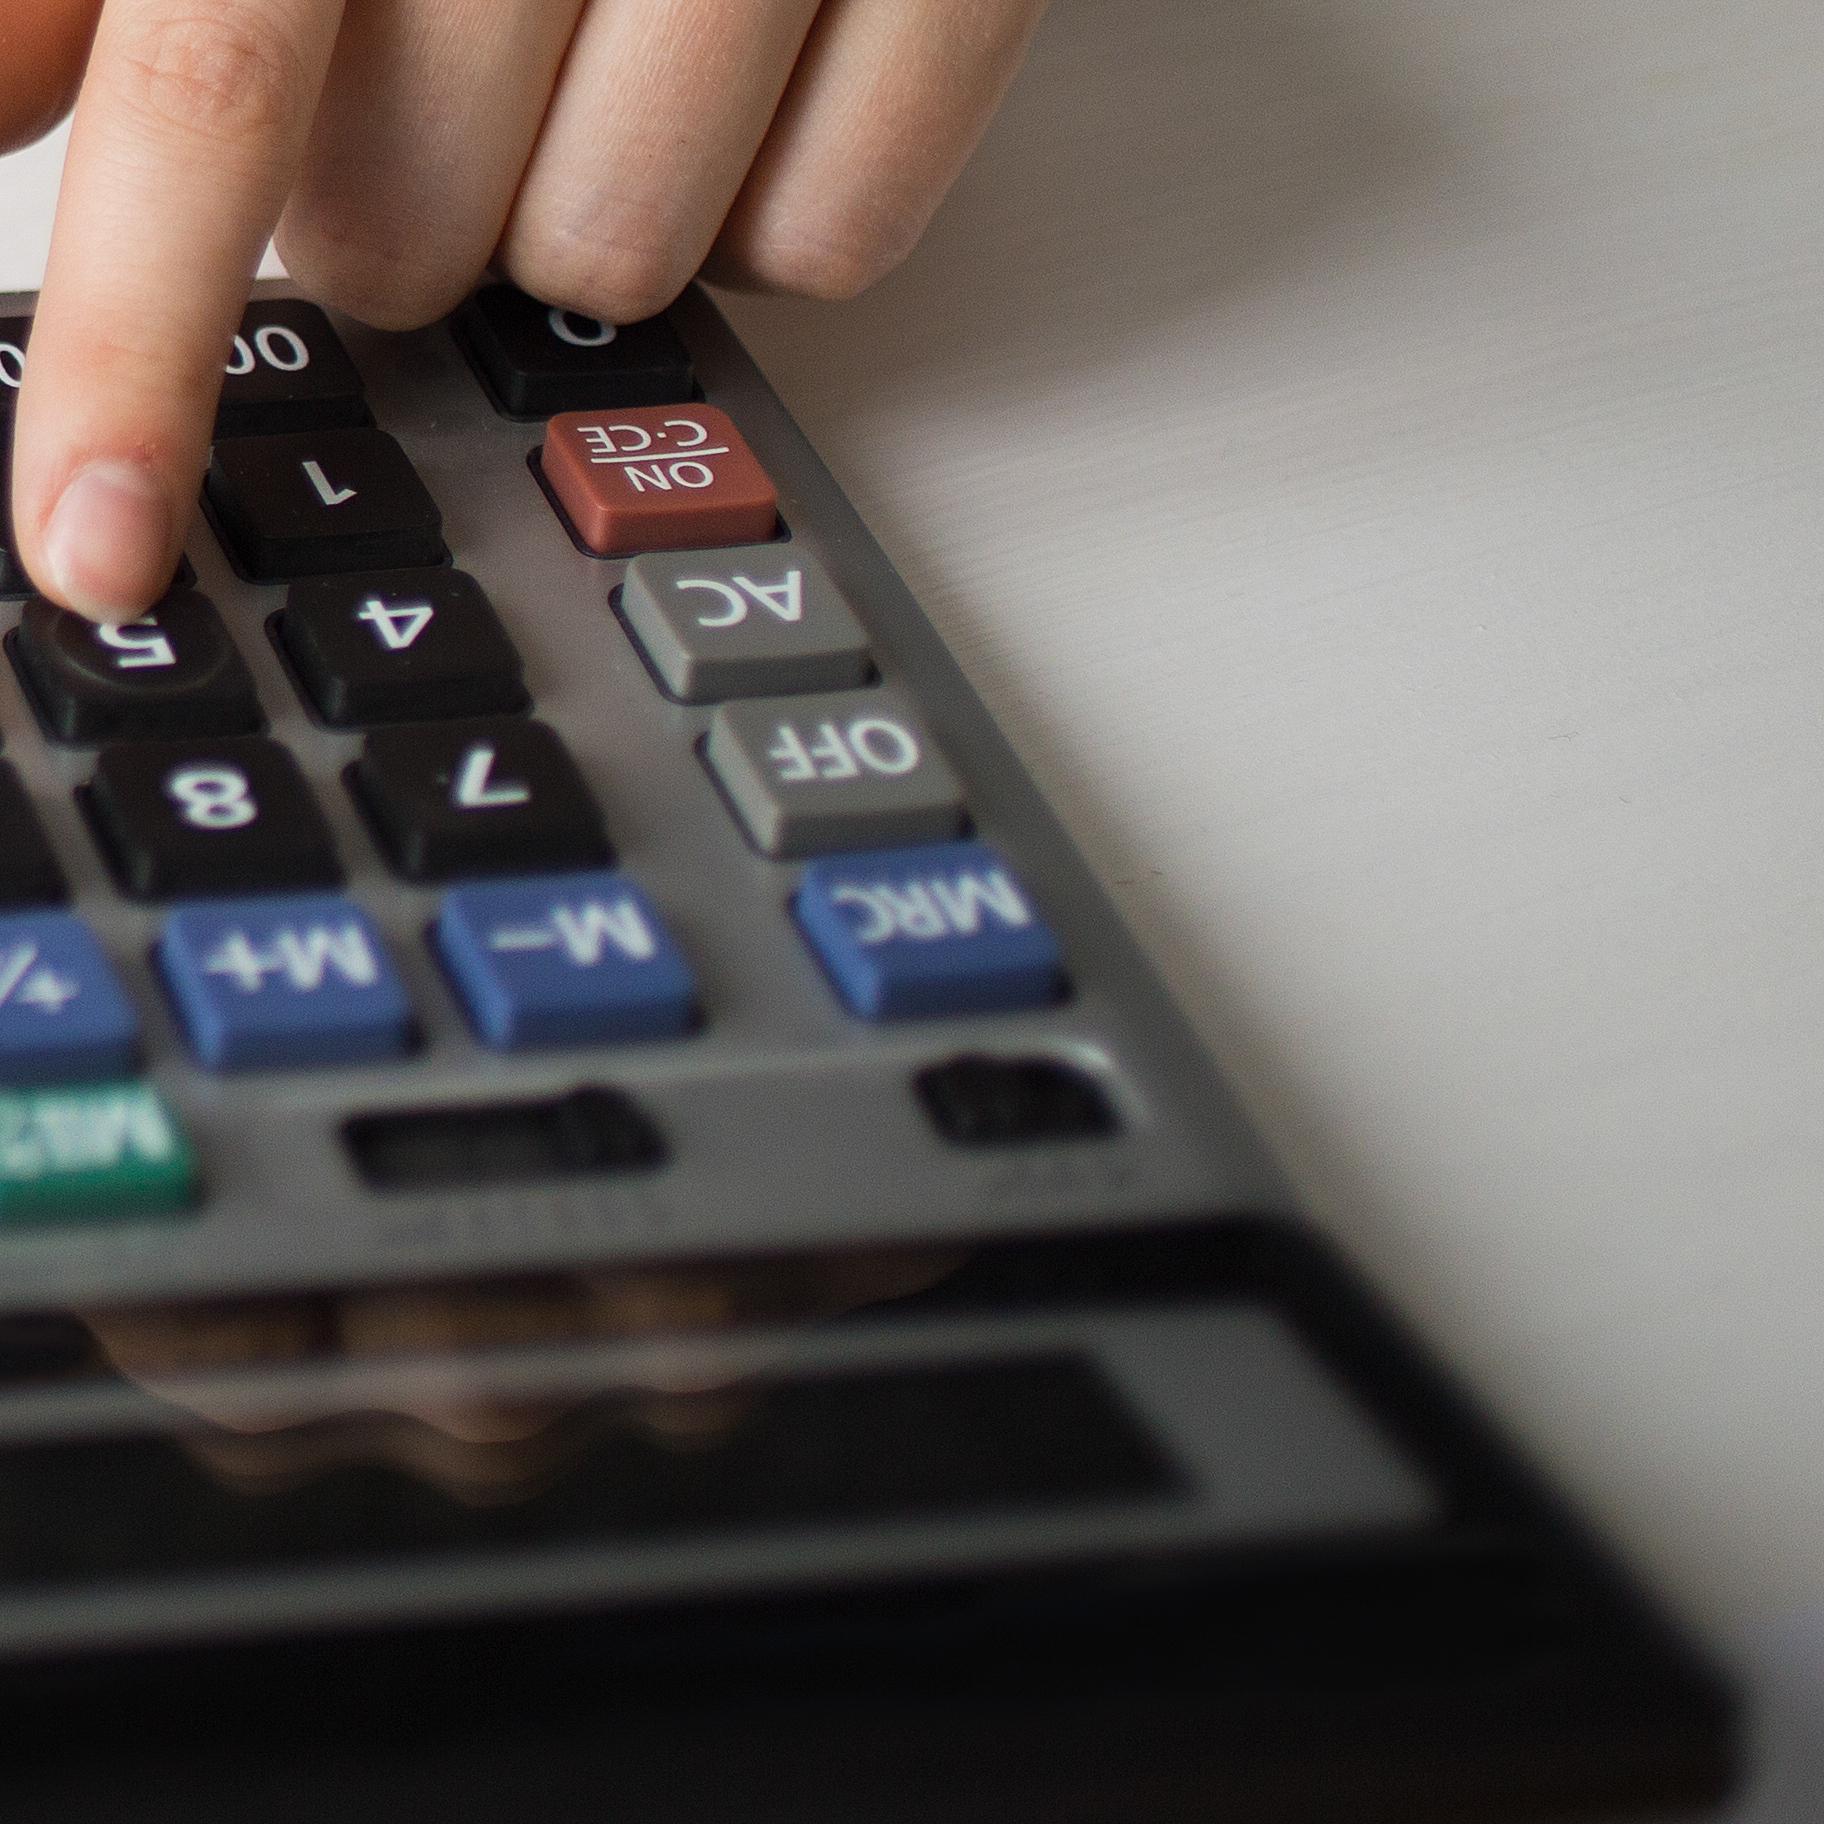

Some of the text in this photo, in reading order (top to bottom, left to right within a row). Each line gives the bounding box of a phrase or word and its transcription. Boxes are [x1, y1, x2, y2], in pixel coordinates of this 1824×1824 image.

[301, 460, 358, 506] 1
[624, 460, 714, 493] ON
[358, 600, 434, 649] 4
[677, 571, 802, 626] AC
[98, 616, 176, 668] 5
[770, 719, 920, 779] OFF
[167, 764, 258, 829] 8
[456, 748, 530, 808] 7
[832, 870, 1032, 944] MRC
[204, 924, 380, 994] M+
